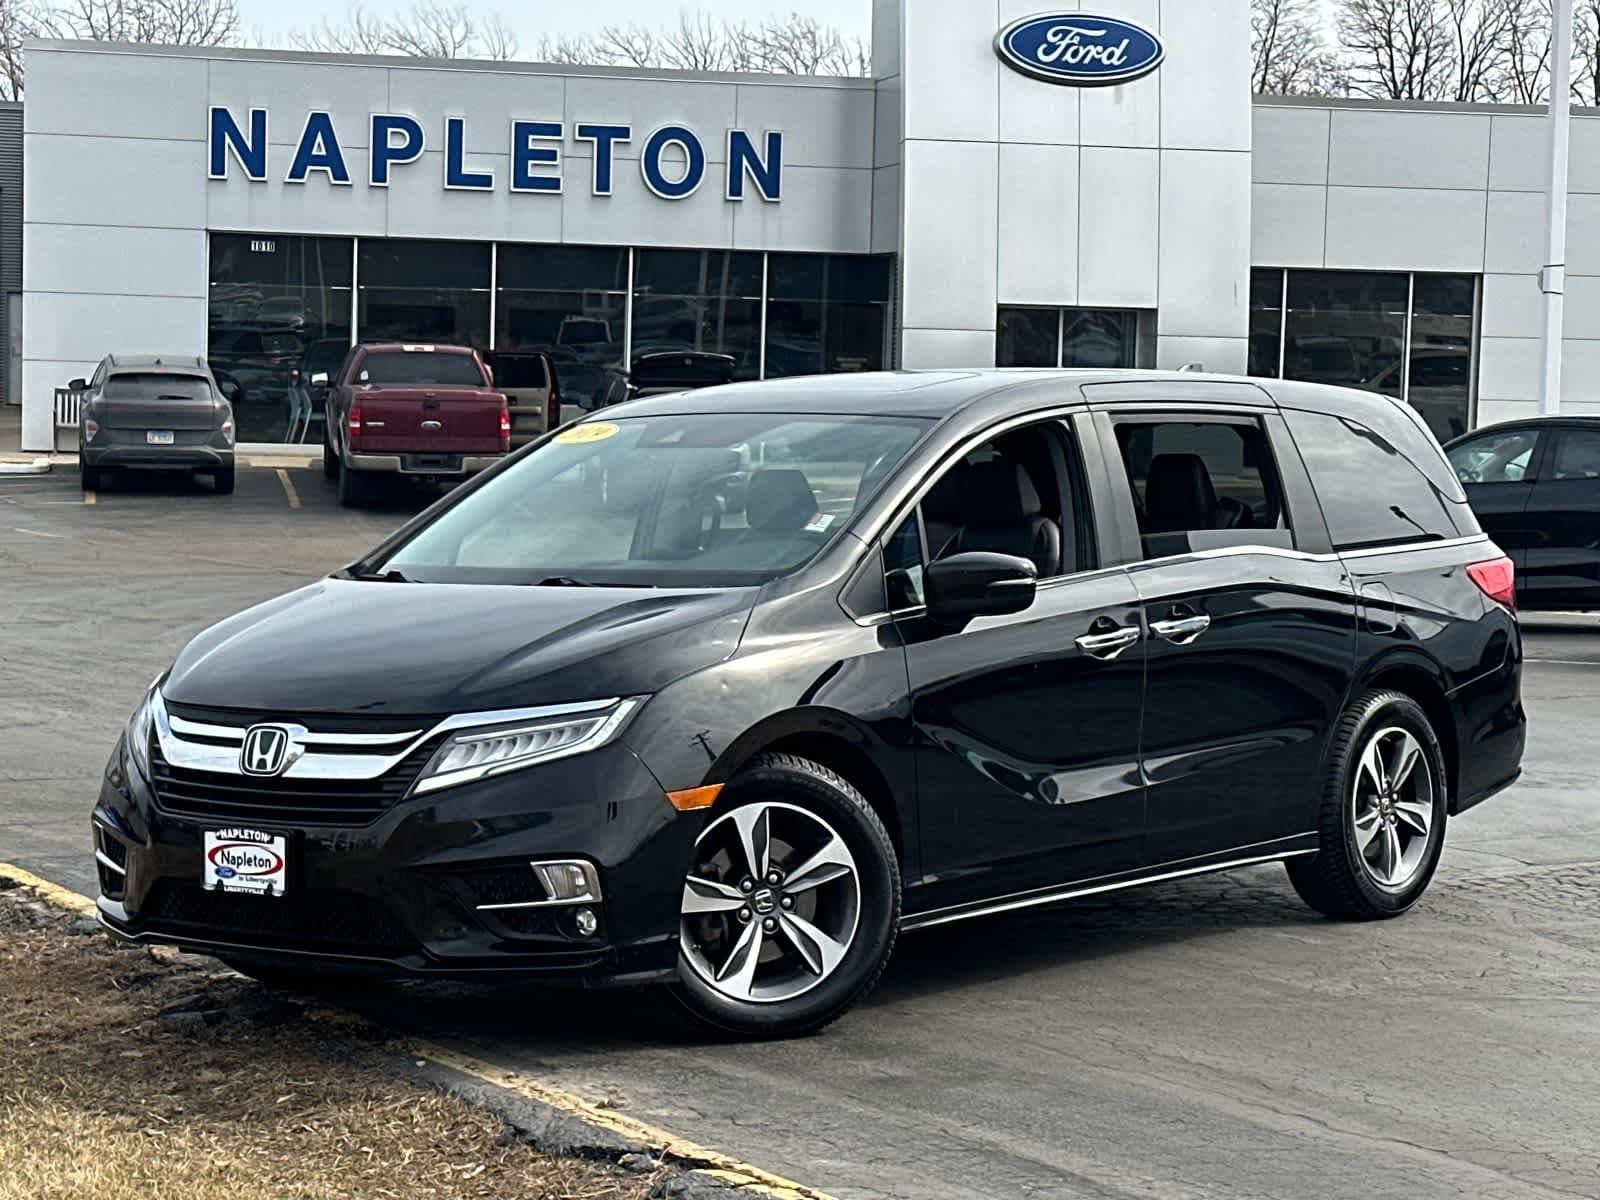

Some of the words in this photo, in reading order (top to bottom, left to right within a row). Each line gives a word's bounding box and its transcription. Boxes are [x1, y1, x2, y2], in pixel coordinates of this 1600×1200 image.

[1037, 25, 1130, 65] Ford
[208, 105, 784, 202] NAPLETON
[220, 828, 269, 842] NAPLETON
[221, 849, 272, 869] Napleton
